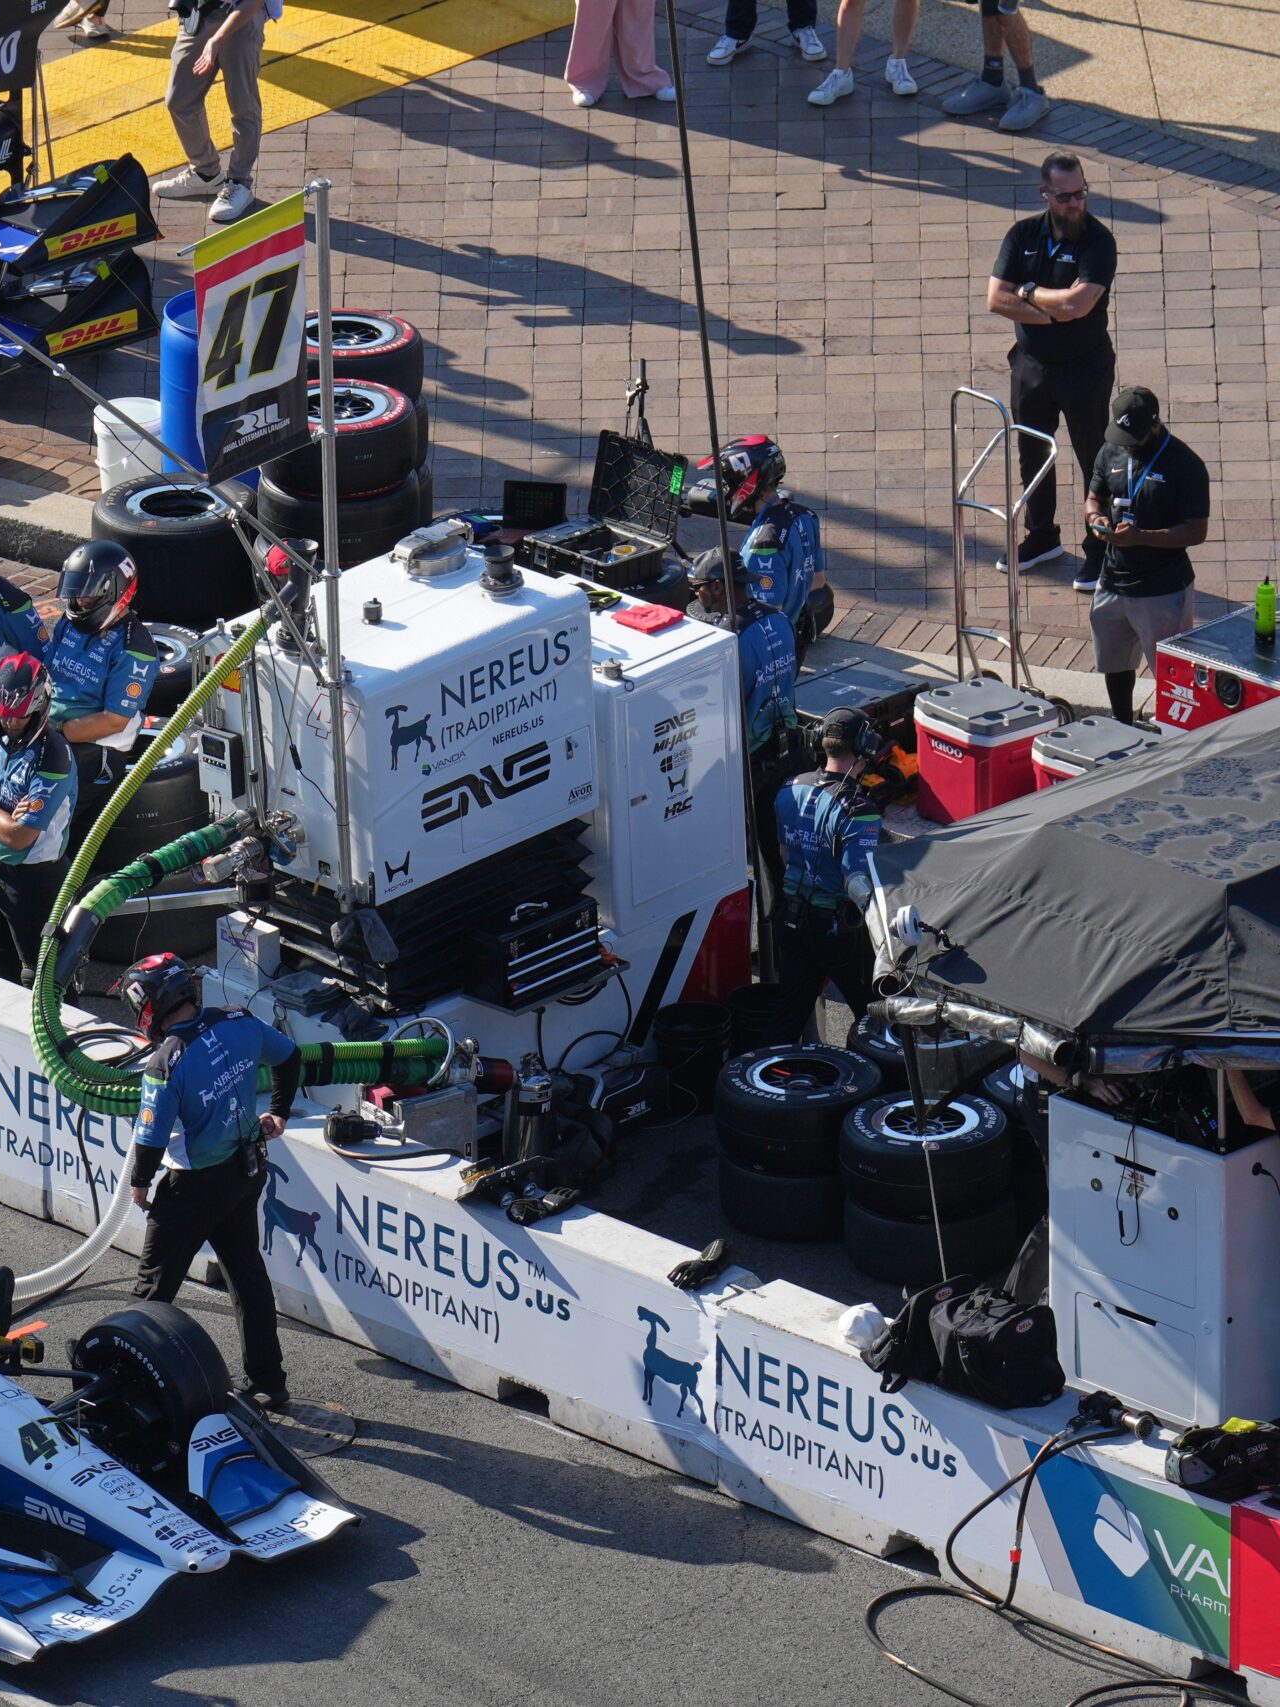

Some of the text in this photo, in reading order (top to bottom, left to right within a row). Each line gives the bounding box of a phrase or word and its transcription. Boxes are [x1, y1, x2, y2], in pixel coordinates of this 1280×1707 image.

[60, 222, 124, 252] DHL
[61, 317, 126, 348] DHL
[203, 262, 300, 392] 47
[440, 679, 558, 749] (TRADIPITANT)
[1167, 703, 1193, 724] 47
[492, 715, 544, 746] NEREUS.US
[653, 725, 699, 754] MI-JACK
[431, 750, 467, 771] VANDA
[568, 784, 593, 800] Avon
[384, 877, 414, 894] Honda
[334, 1249, 500, 1344] (TRADIPITANT)
[1018, 1320, 1032, 1332] BELL
[113, 1336, 165, 1388] Firestone
[18, 1416, 80, 1466] 47
[713, 1401, 884, 1499] (TRADIPITANT)
